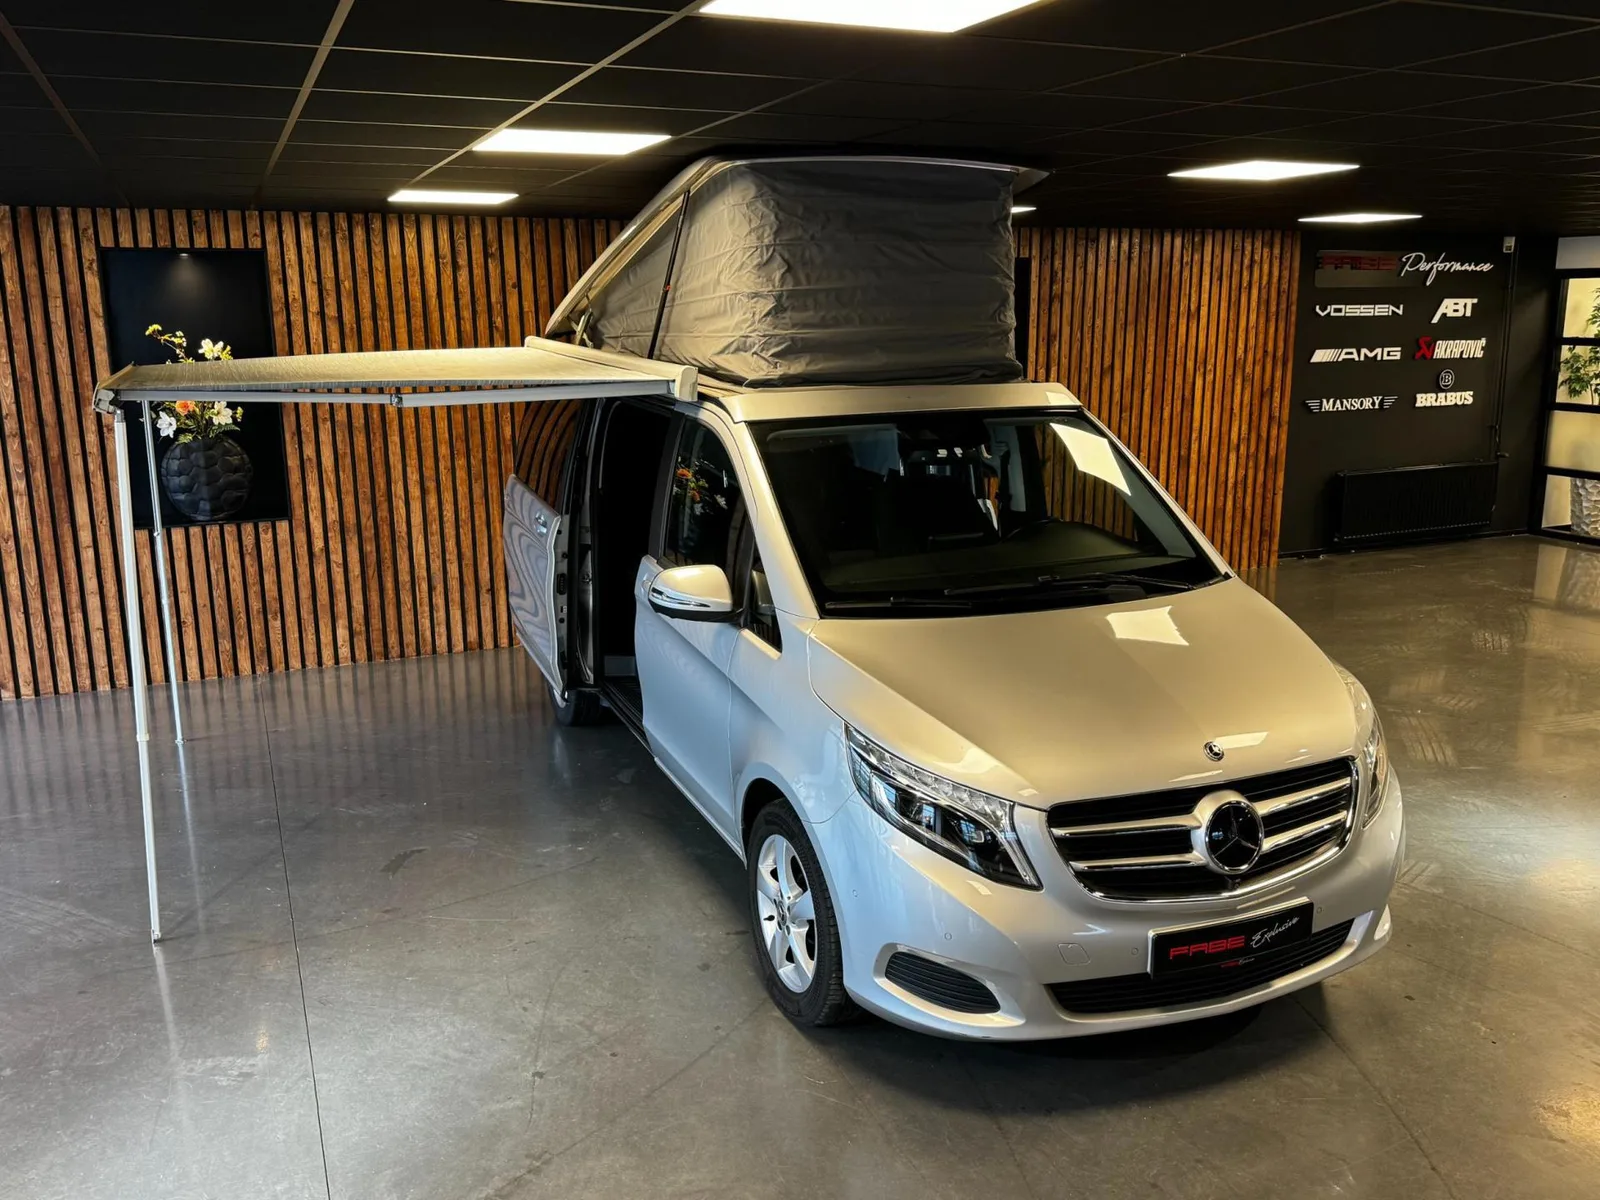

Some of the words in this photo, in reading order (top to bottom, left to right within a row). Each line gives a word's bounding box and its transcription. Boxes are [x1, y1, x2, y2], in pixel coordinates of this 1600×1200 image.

[1401, 252, 1493, 286] Performance
[1315, 304, 1403, 316] VOSSEN
[1431, 298, 1478, 323] ABT
[1338, 347, 1401, 361] AMG
[1321, 396, 1383, 412] MANSORY
[1415, 391, 1473, 407] BRABUS
[1169, 935, 1246, 960] FABE
[1250, 916, 1300, 948] Exclusive
